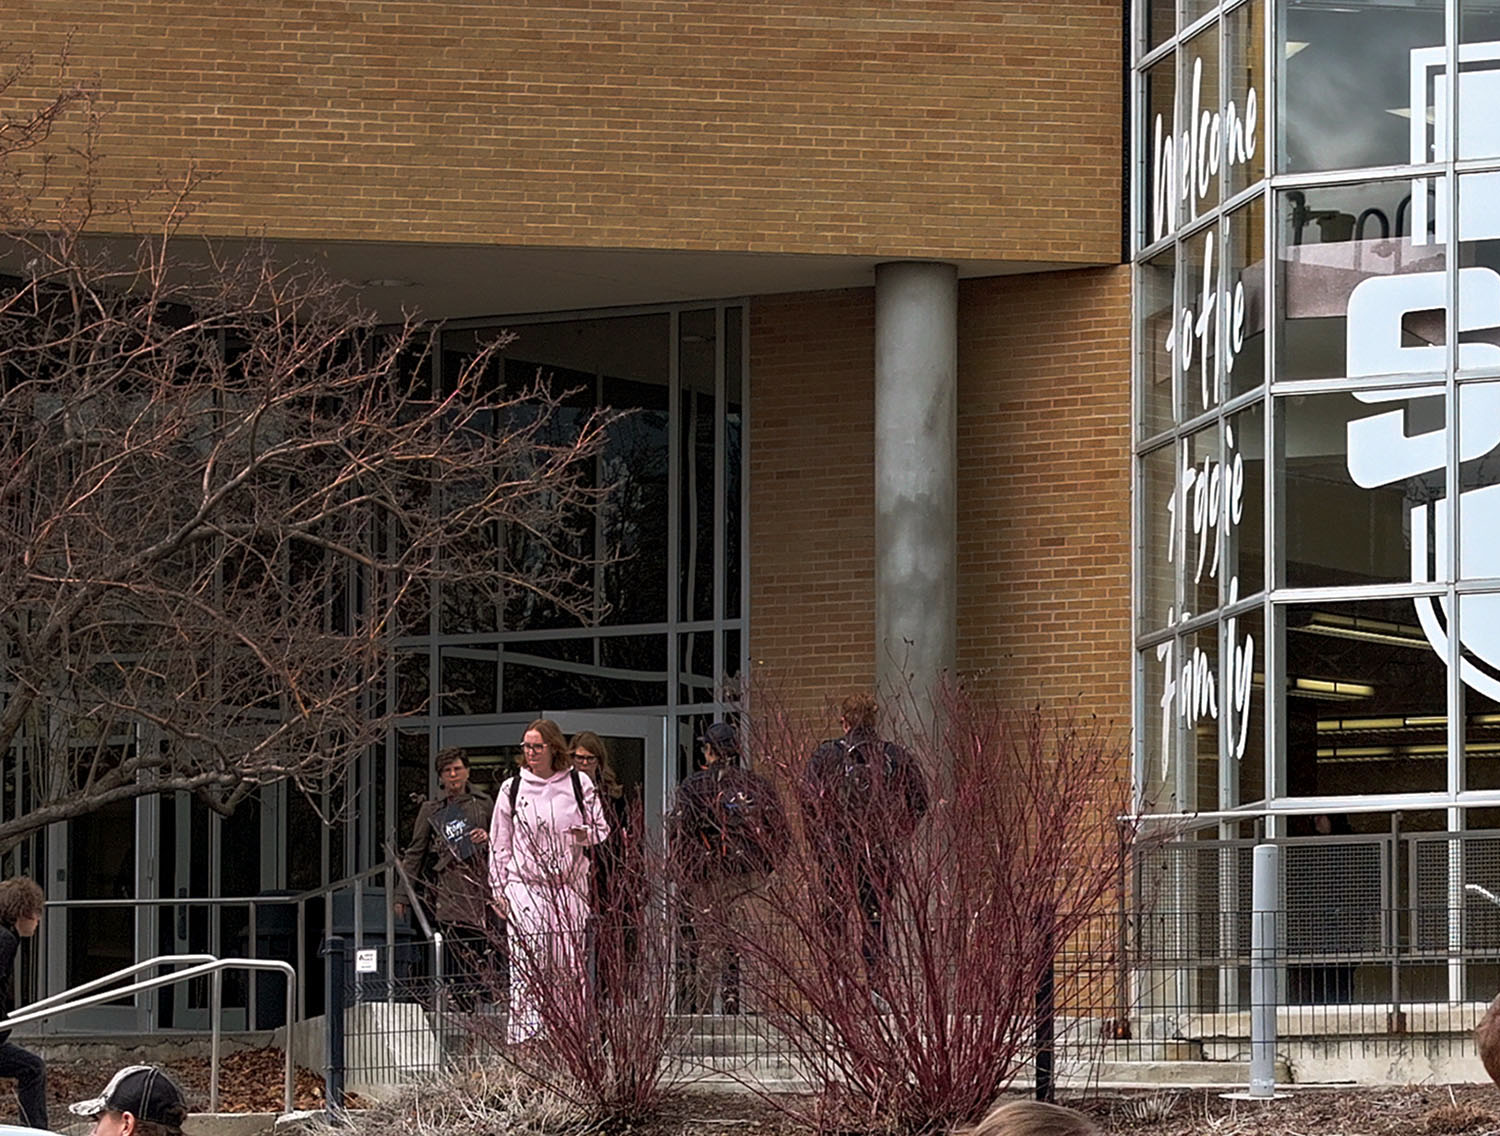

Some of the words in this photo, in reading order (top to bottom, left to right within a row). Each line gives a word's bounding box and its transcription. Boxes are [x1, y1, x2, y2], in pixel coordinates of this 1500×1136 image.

[1154, 56, 1257, 242] Welcome
[1167, 424, 1243, 584] Aggie
[1157, 576, 1253, 782] Famly
